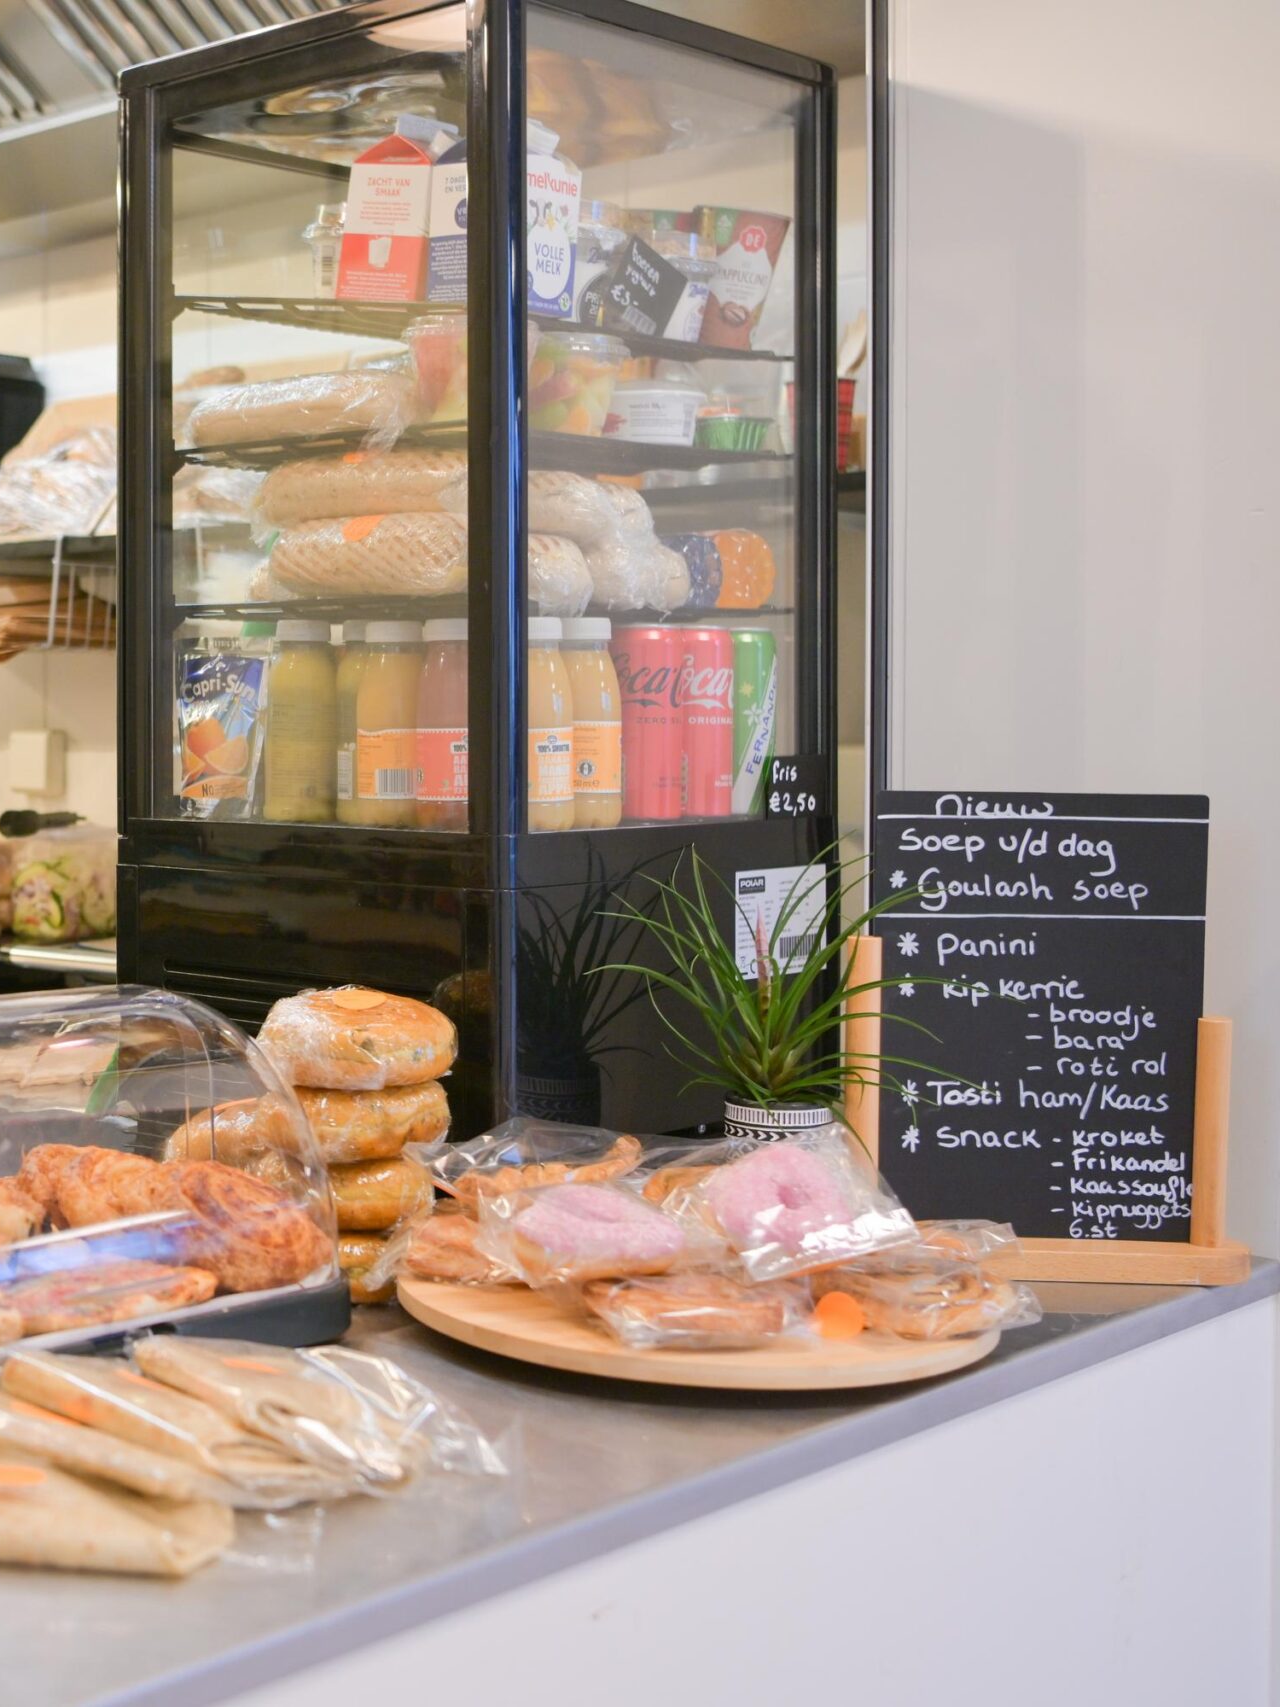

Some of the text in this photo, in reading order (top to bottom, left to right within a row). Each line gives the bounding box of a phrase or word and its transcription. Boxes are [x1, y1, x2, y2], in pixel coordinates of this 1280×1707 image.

[534, 242, 565, 262] VOLLE
[536, 259, 561, 275] MELK
[181, 673, 256, 702] Capri-Sun
[769, 792, 816, 817] €2,50
[1058, 833, 1116, 877] dag
[740, 878, 764, 889] POLAR
[917, 867, 1054, 911] Goulash
[1049, 1002, 1157, 1041] broodje
[1053, 1025, 1125, 1050] bara
[1056, 1051, 1168, 1077] roti rol
